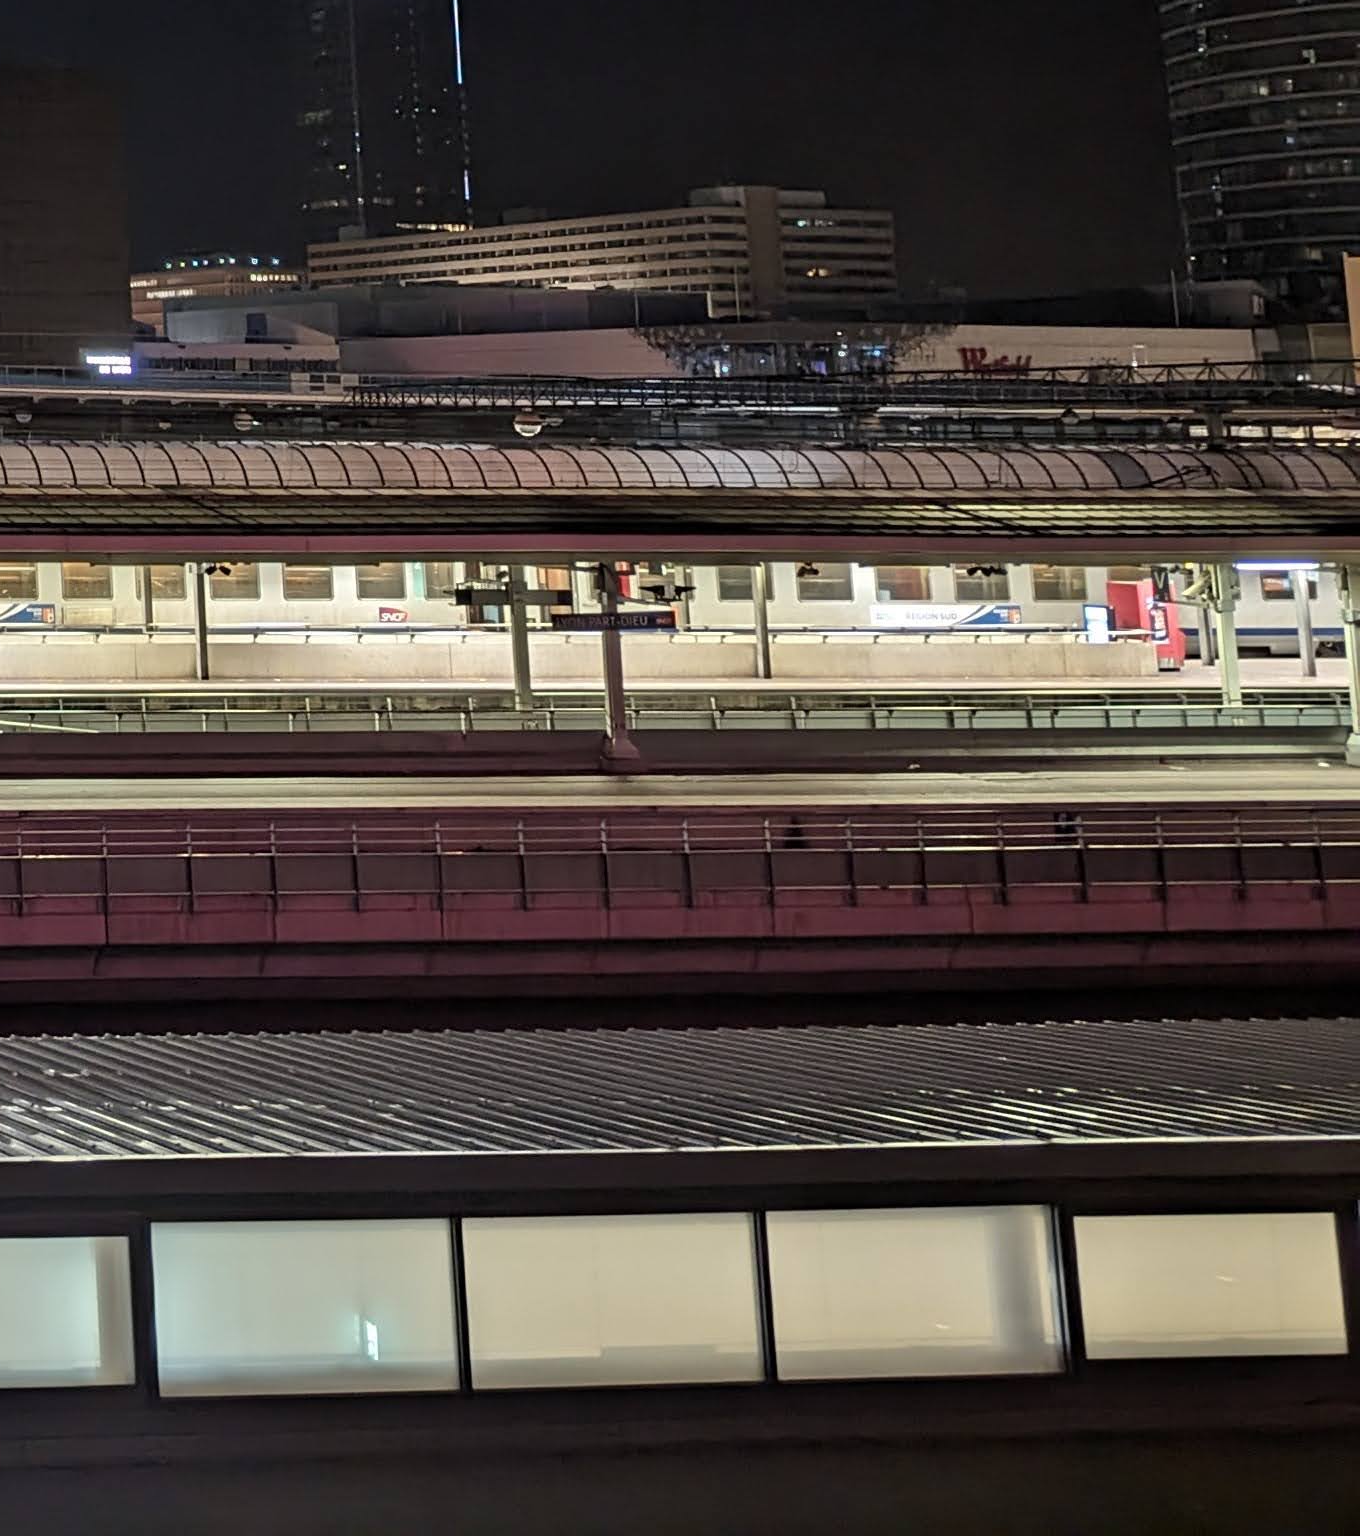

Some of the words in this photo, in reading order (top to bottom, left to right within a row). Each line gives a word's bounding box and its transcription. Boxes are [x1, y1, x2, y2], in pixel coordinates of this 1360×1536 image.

[381, 612, 406, 622] SNCF
[555, 617, 586, 629] LYON
[590, 615, 649, 627] PART-DIEU
